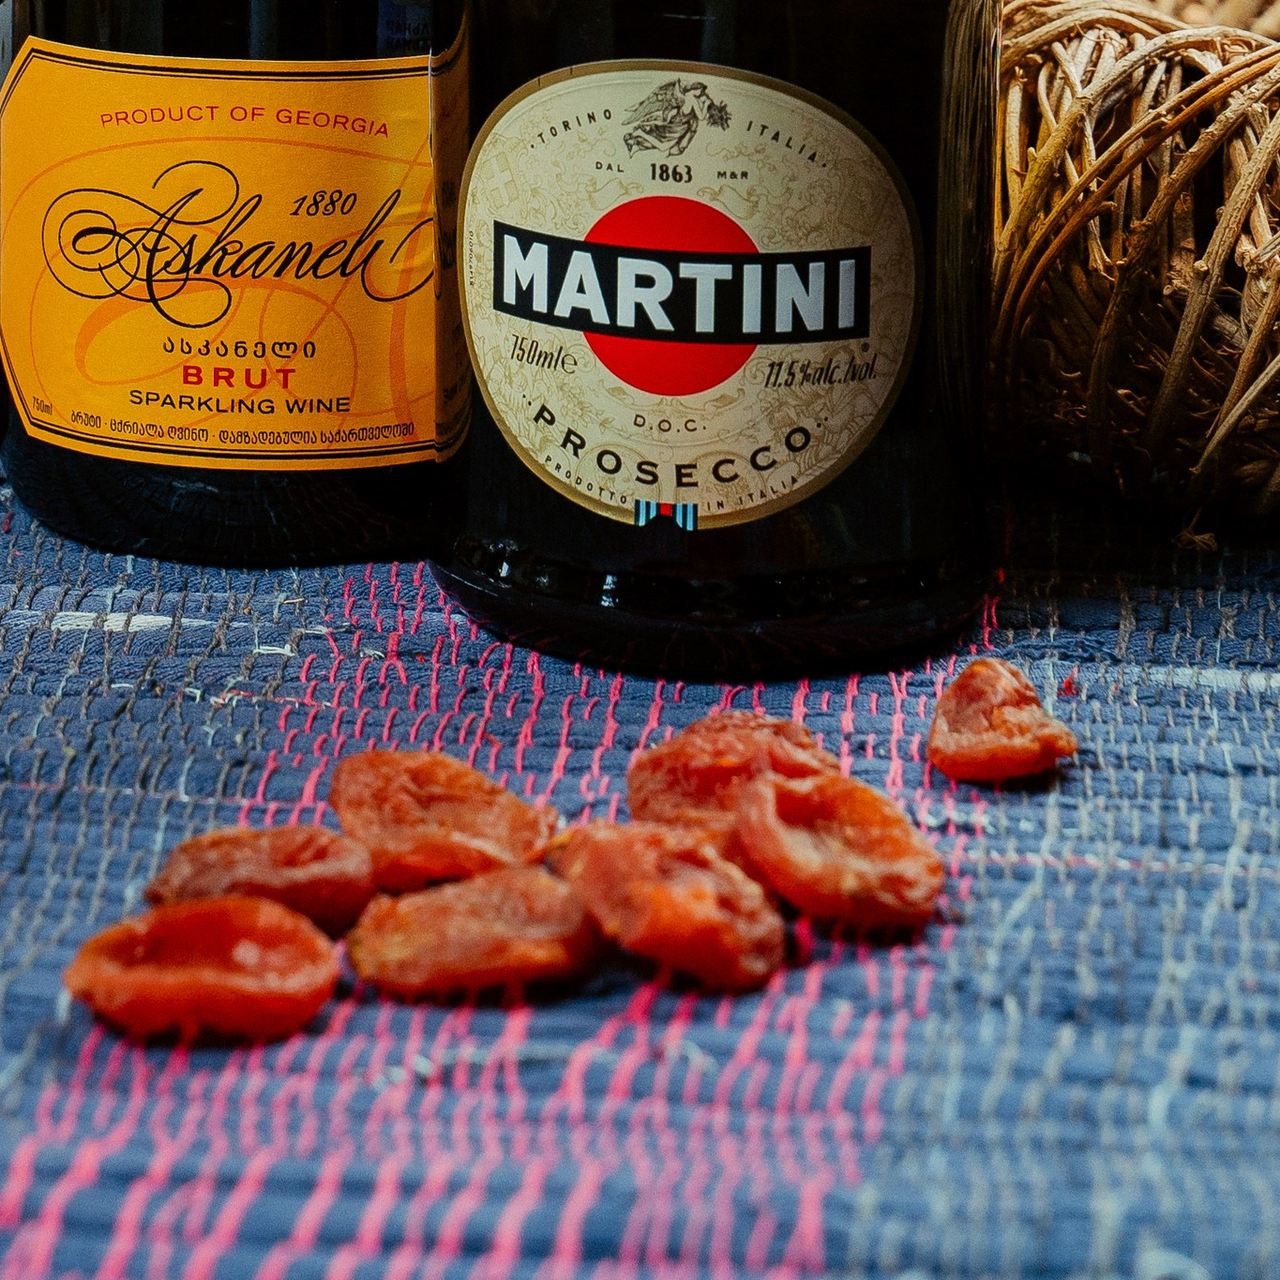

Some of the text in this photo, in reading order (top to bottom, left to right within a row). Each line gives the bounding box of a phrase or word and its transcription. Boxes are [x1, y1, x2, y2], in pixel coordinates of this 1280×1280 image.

[100, 105, 389, 138] PRODUCT OF GEORGIA
[538, 108, 819, 163] TORINO ITALIA
[595, 161, 749, 183] DAL 1863 M&R
[289, 190, 358, 216] 1880
[503, 233, 856, 334] MARTINI
[163, 337, 316, 359] ასკანელი
[182, 365, 296, 389] BRUT
[32, 396, 53, 416] 750ml
[129, 390, 351, 414] SPARKLING WINE
[634, 413, 707, 434] D.O.C.
[533, 404, 812, 489] PROSECCO
[545, 454, 799, 511] PRODOTTO IN ITALIA
